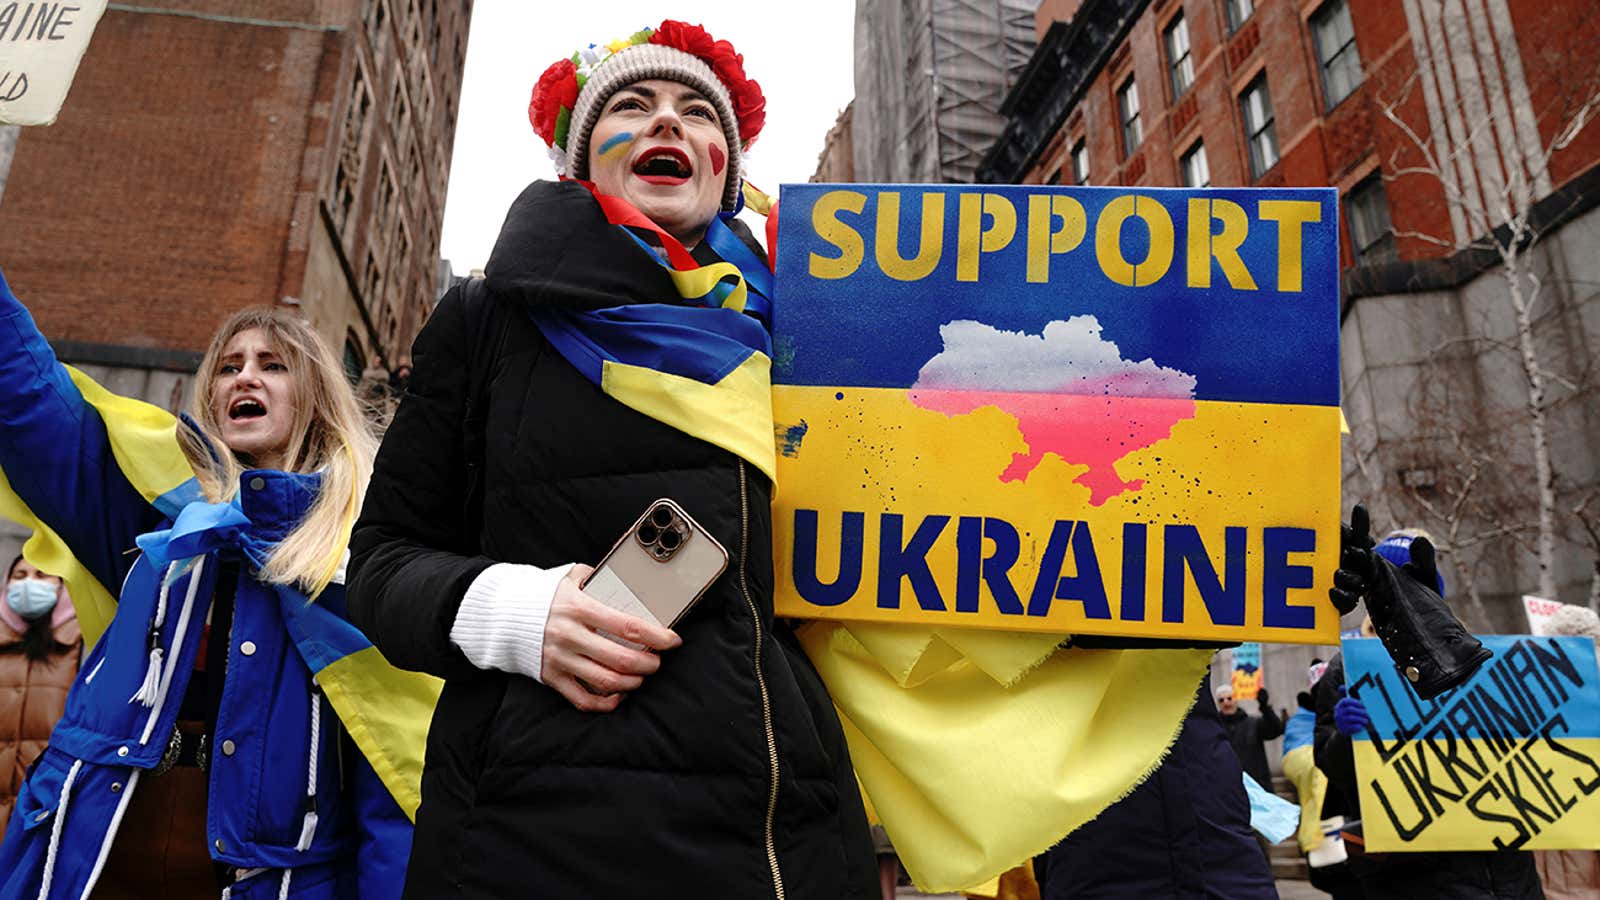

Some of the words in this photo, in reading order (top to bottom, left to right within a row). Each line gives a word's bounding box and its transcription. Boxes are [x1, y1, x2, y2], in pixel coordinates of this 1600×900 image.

[808, 190, 1322, 293] SUPPORT
[791, 508, 1317, 630] UKRAINE
[1371, 638, 1584, 842] UKRAINIAN
[1466, 713, 1600, 850] SKIES
